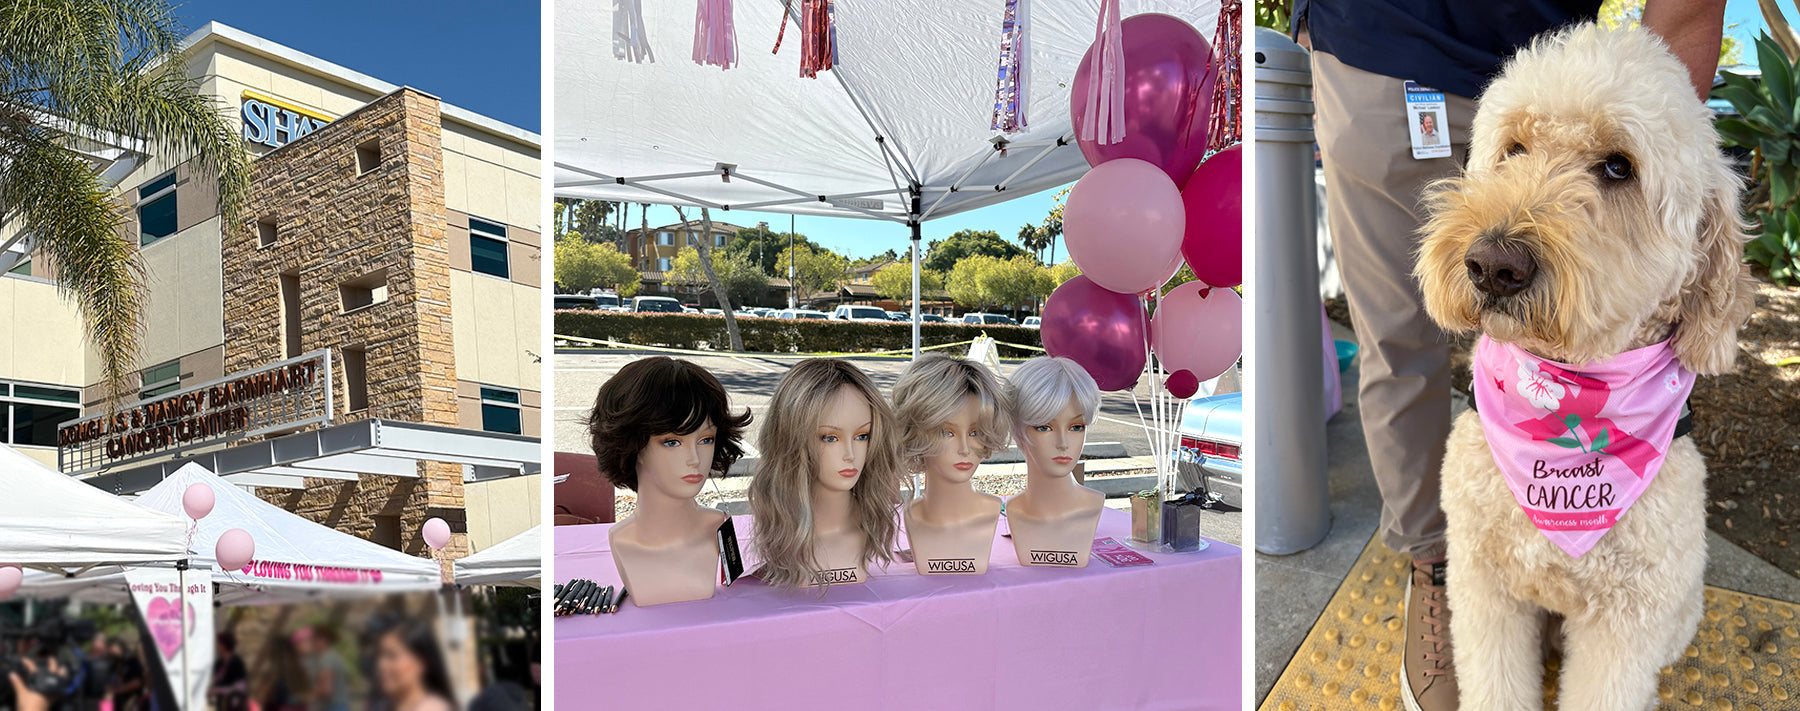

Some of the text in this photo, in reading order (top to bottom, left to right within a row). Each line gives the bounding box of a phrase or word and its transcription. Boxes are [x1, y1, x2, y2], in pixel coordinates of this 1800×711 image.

[131, 408, 143, 429] &
[146, 391, 206, 426] NANCY
[209, 360, 319, 408] BARNHART
[106, 407, 248, 459] CANCER CENTER
[1533, 457, 1604, 479] Breast
[1526, 482, 1616, 510] CANCER
[1532, 514, 1608, 527] Awareness month
[928, 560, 976, 572] WIGUSA
[1031, 552, 1078, 564] WIGUSA
[253, 559, 291, 580] LOVING
[293, 563, 313, 582] YOU
[154, 582, 168, 593] You
[169, 583, 199, 595] Thrgh
[200, 583, 206, 593] It
